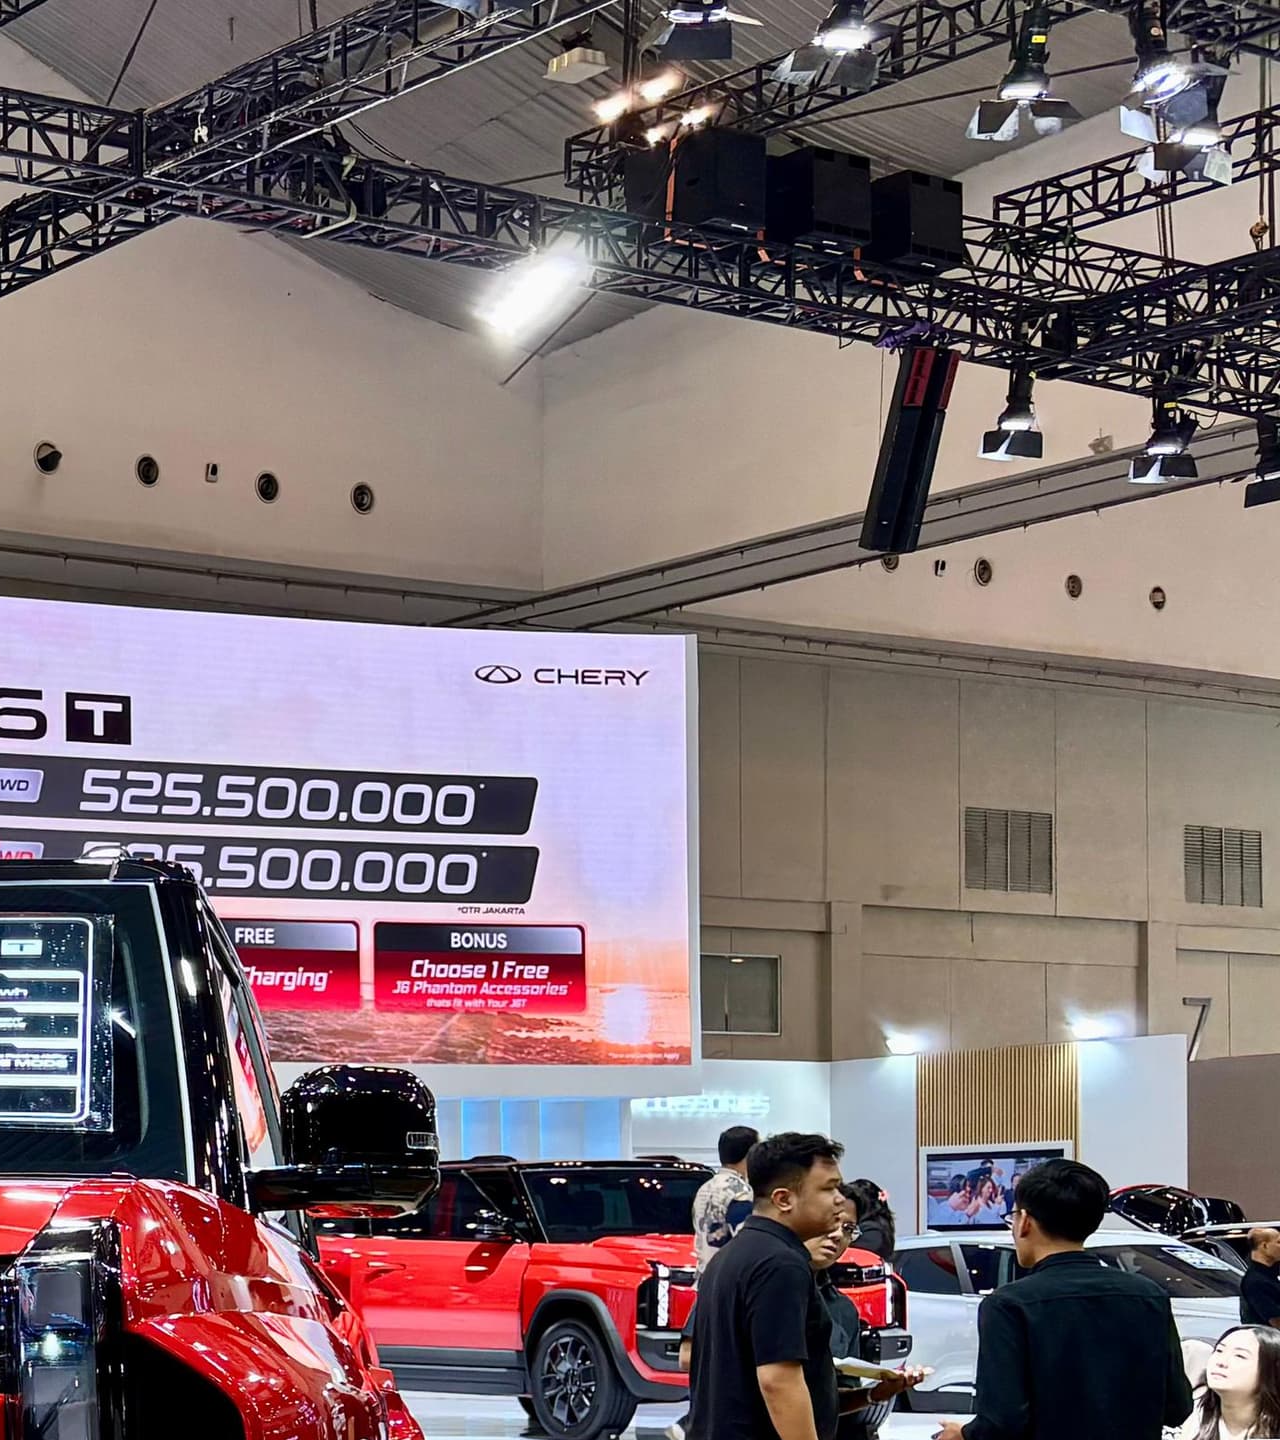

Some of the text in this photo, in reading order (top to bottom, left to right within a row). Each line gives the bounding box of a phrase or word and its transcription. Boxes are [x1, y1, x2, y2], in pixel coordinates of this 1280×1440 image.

[534, 668, 650, 686] CHERY
[483, 906, 526, 915] JAKARTA
[235, 927, 275, 944] FREE
[451, 932, 507, 949] BONUS
[410, 959, 550, 979] Choose 1 Free
[392, 981, 411, 994] J6
[413, 981, 477, 994] Phantom
[1182, 997, 1212, 1062] 7
